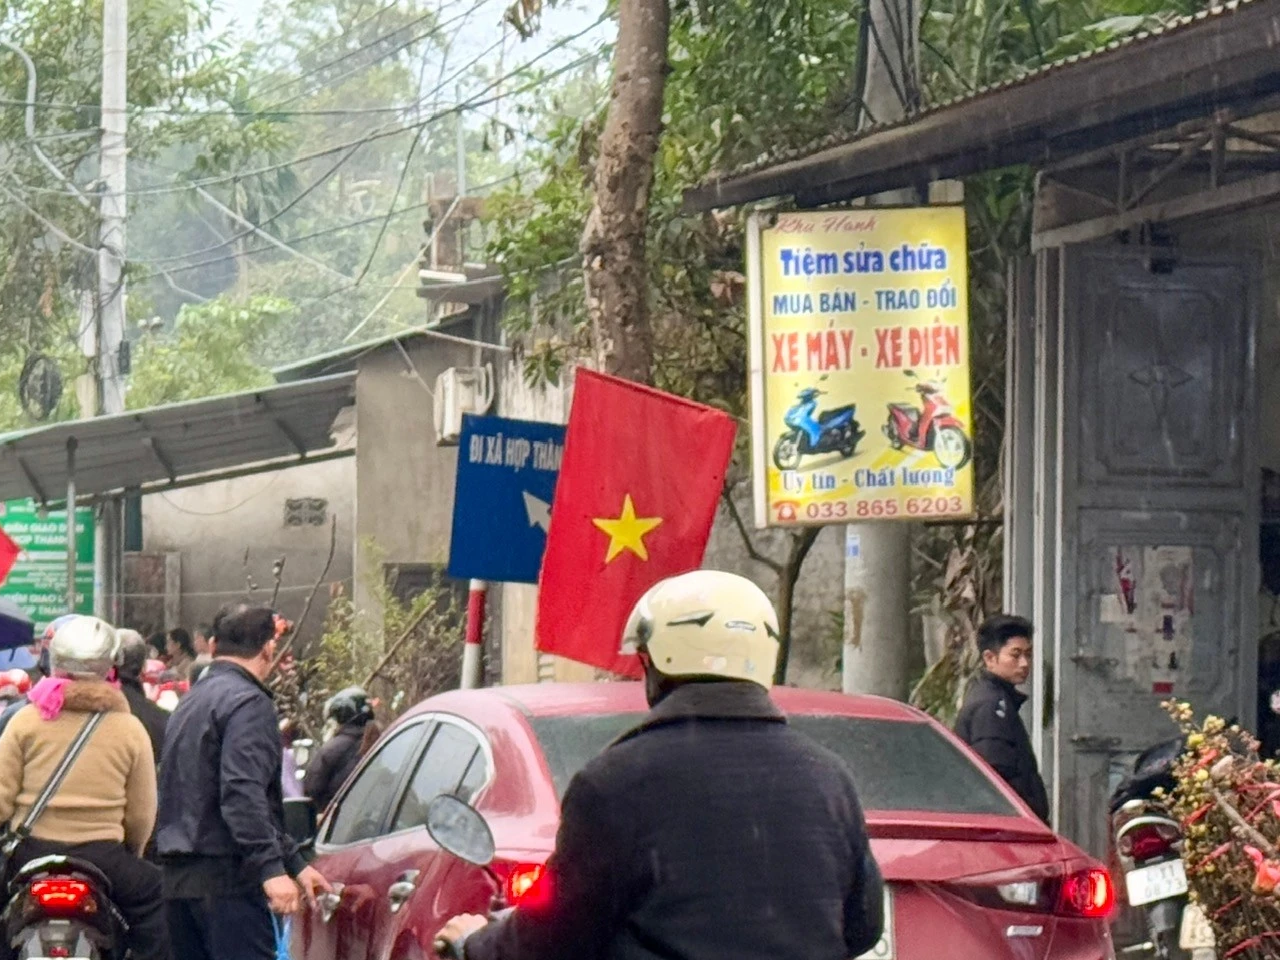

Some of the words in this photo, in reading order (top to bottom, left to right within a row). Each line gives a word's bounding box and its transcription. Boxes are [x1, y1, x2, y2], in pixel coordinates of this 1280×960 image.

[780, 247, 838, 281] Tiệm
[843, 242, 884, 274] sửa
[889, 243, 947, 272] chữa
[773, 294, 813, 315] MUA
[820, 288, 856, 312] BÁN
[875, 289, 920, 310] TRAO
[927, 278, 956, 308] ĐỔI
[772, 332, 799, 373] XE
[807, 319, 853, 372] MÁY
[875, 327, 902, 369] XE
[533, 437, 563, 471] THÀN
[806, 502, 848, 518] 033
[856, 499, 898, 516] 865
[906, 496, 962, 514] 6203
